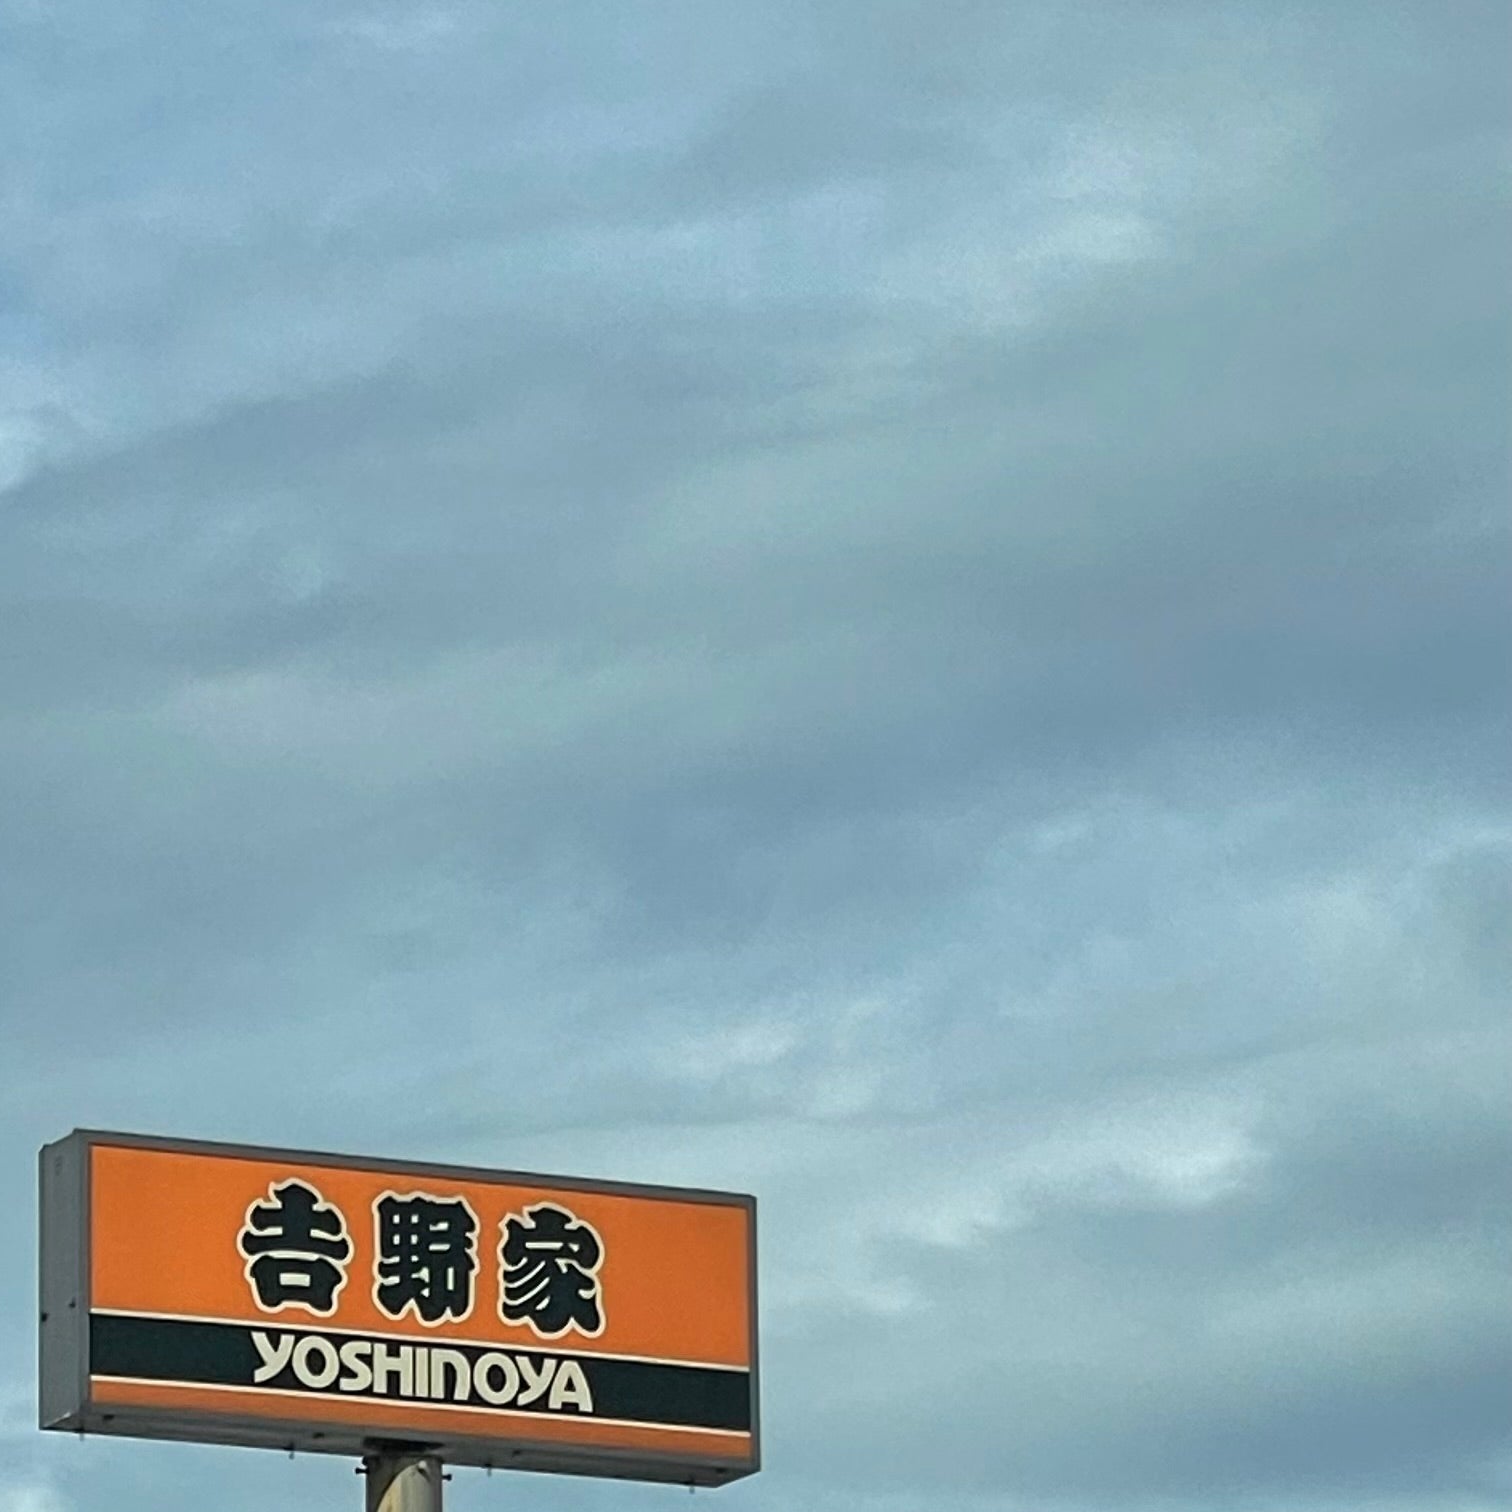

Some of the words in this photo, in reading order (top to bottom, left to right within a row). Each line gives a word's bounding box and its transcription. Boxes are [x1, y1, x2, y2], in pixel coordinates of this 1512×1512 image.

[236, 1176, 605, 1341] 吉野家
[250, 1331, 595, 1413] YOSHINOYA
